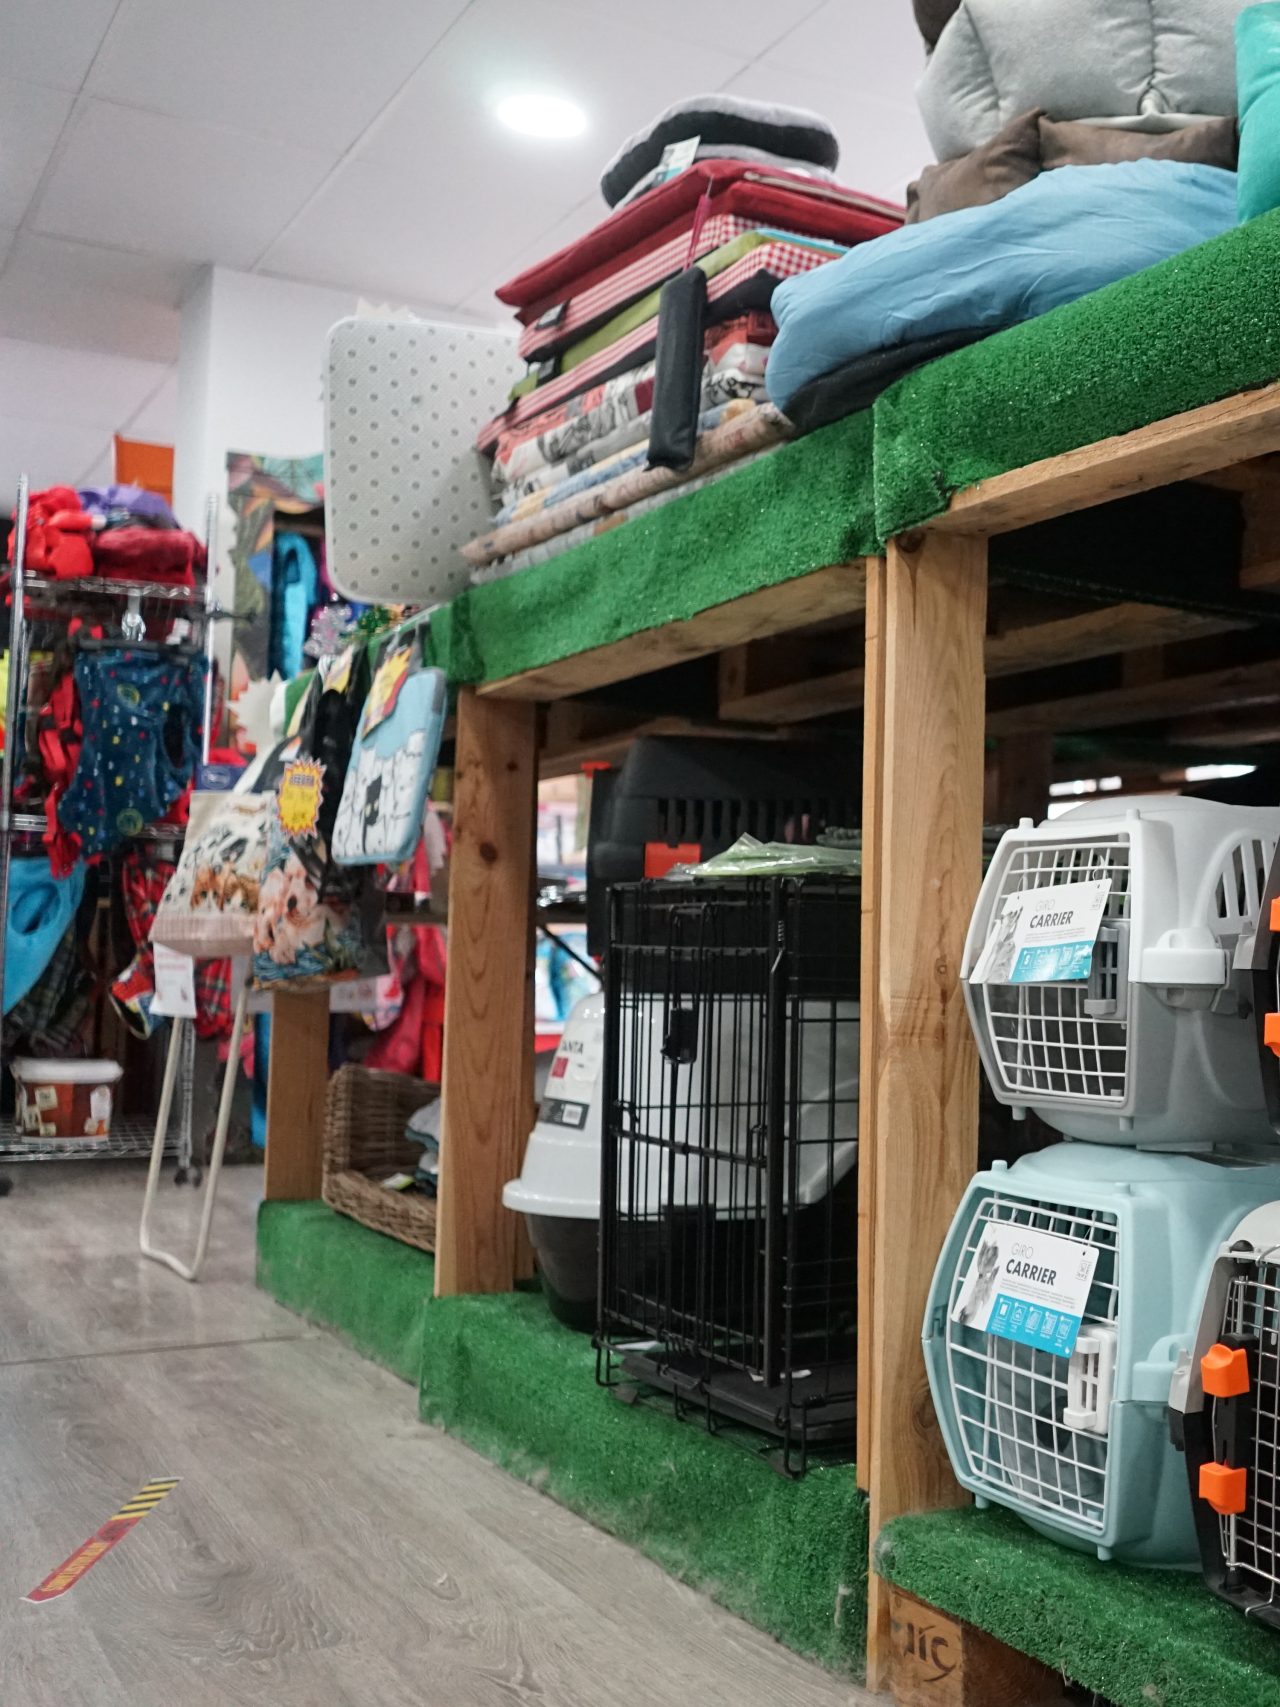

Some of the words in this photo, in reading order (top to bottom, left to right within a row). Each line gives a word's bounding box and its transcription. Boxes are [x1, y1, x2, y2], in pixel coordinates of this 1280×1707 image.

[1029, 911, 1074, 928] CARRIER
[1011, 1241, 1034, 1260] GIRO
[1005, 1258, 1057, 1286] CARRIER
